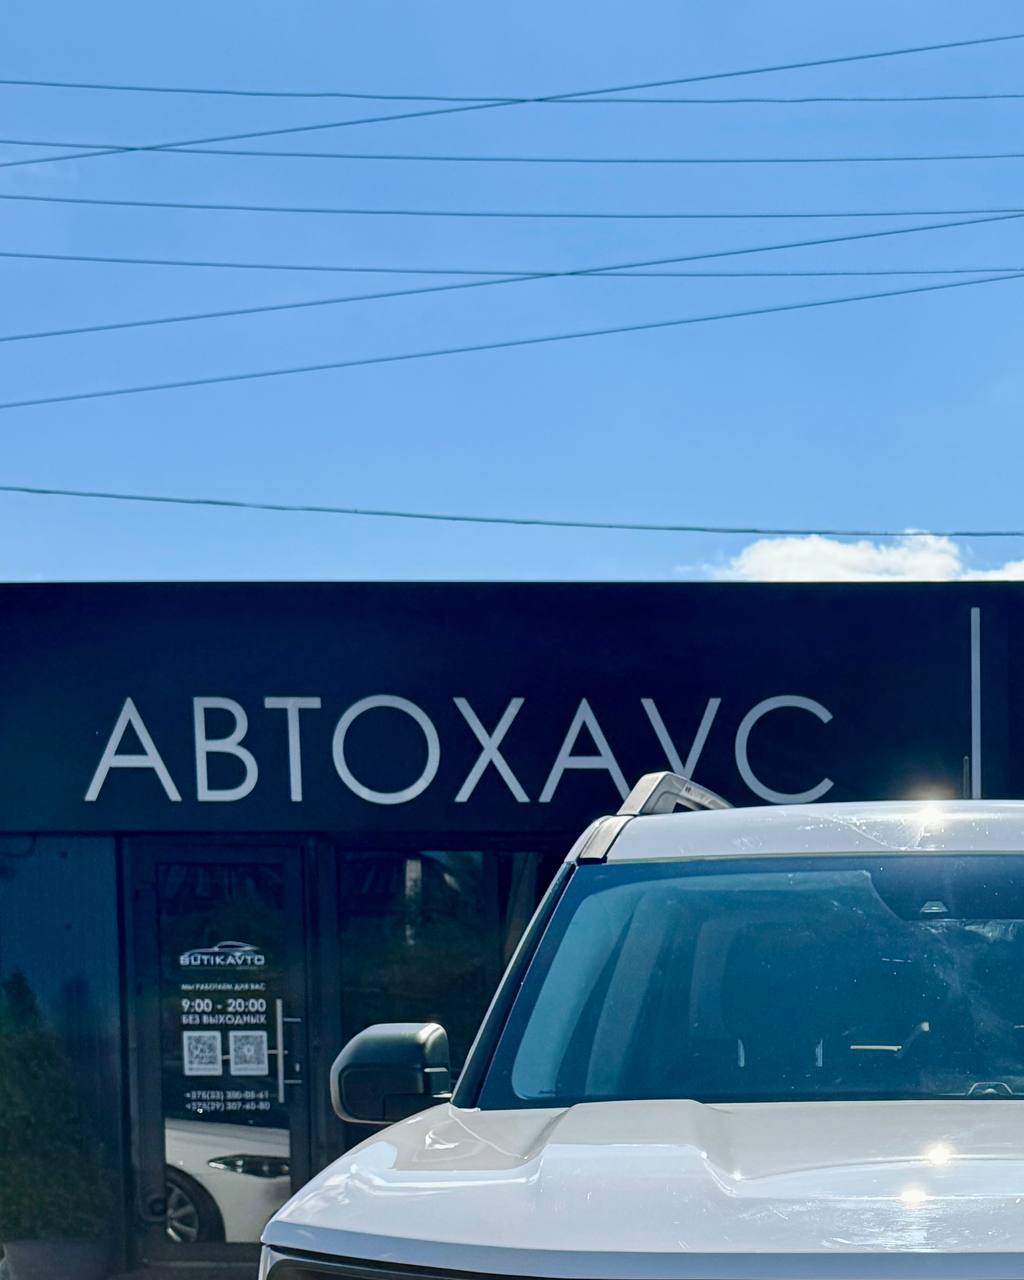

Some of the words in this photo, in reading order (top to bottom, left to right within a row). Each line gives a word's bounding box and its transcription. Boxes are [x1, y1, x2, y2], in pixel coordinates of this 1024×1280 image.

[84, 694, 836, 805] АВТОХАУС
[179, 954, 265, 966] BUTIKAVTO
[182, 998, 212, 1012] 9:00
[227, 998, 266, 1012] 20:00
[182, 1014, 200, 1024] БЕЗ
[203, 1014, 266, 1025] ВЫХОДНЫХ
